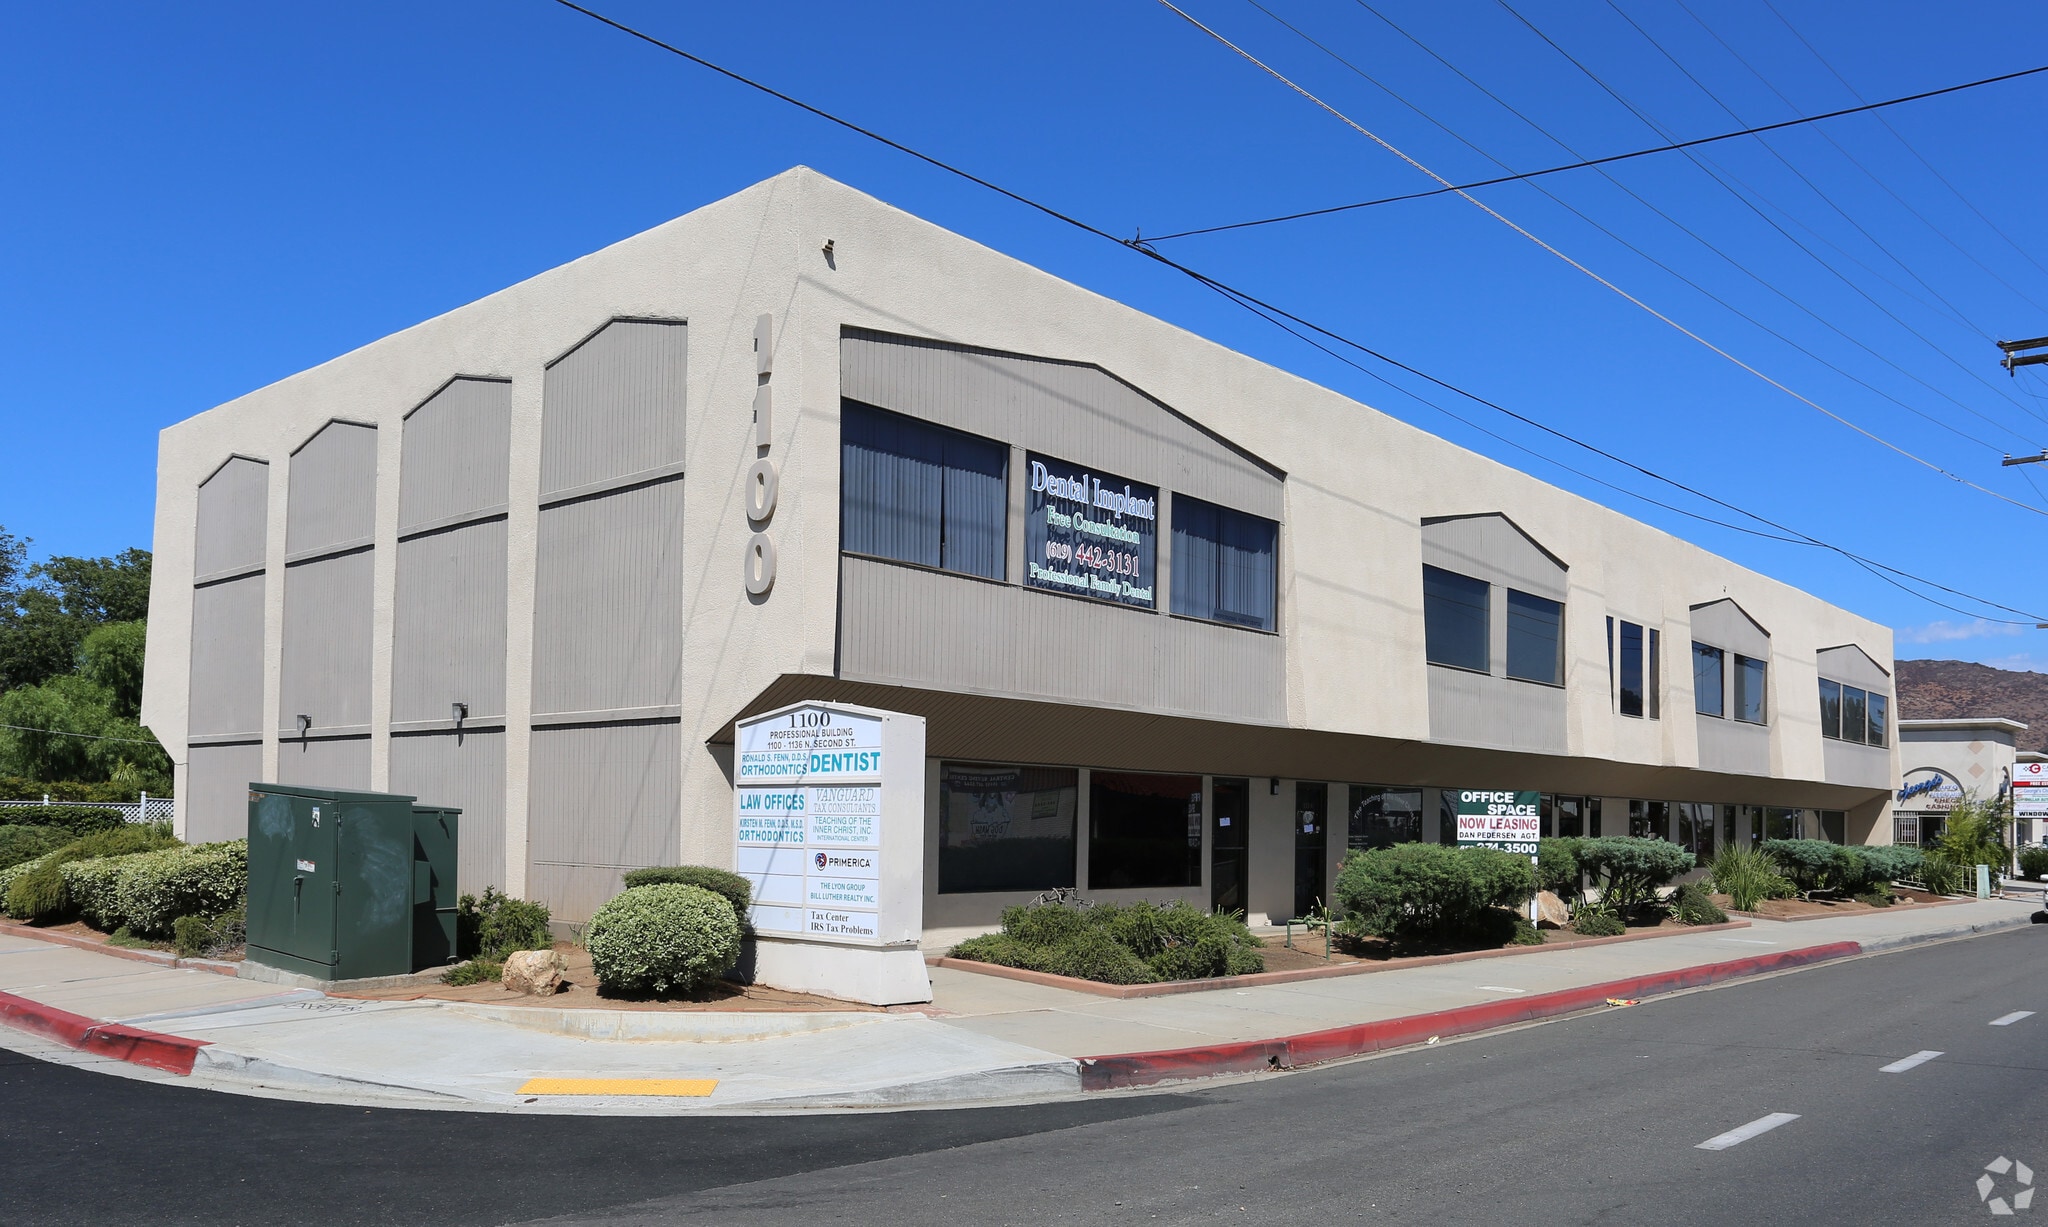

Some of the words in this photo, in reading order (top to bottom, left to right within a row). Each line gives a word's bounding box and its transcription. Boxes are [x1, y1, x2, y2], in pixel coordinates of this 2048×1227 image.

[744, 312, 779, 595] 1100
[1031, 460, 1089, 505] Dental
[1092, 477, 1155, 520] Implant
[1046, 505, 1072, 529] Free
[1072, 512, 1140, 544] Consultation
[1045, 540, 1072, 563] (619)
[1075, 543, 1140, 577] 442-3131
[1029, 562, 1089, 588] Professional
[1090, 573, 1122, 597] Family
[1122, 581, 1153, 601] Dental
[788, 711, 831, 728] 1100
[770, 729, 820, 739] PROFESSIONAL
[822, 728, 853, 737] BUILDING
[767, 741, 782, 749] 1100
[788, 740, 803, 749] 1136
[805, 740, 812, 748] N.
[813, 739, 843, 748] SECOND
[845, 739, 856, 747] ST.
[742, 754, 765, 762] RONALD
[774, 753, 791, 763] FENN,
[810, 751, 881, 773] DENTIST
[741, 763, 808, 775] ORTHODONTICS
[816, 788, 874, 802] VANGUARD
[1460, 791, 1514, 803] OFFICE
[740, 795, 762, 810] LAW
[764, 794, 805, 811] OFFICES
[813, 804, 827, 813] TAX
[828, 803, 876, 814] CONSULTANTS
[1487, 804, 1536, 816] SPACE
[740, 818, 758, 828] KIRSTEN
[815, 816, 847, 825] TEACHING
[848, 816, 858, 825] OF
[858, 817, 872, 825] THE
[1459, 817, 1486, 829] NOW
[1489, 818, 1538, 830] LEASING
[739, 830, 804, 843] ORTHODONTICS
[812, 826, 833, 834] INNER
[833, 826, 858, 835] CHRIST,
[859, 826, 873, 835] INC.
[828, 857, 871, 868] PRIMERICA
[820, 882, 831, 890] THE
[831, 882, 846, 891] LYON
[846, 883, 866, 892] GROUP
[810, 892, 822, 900] BILL
[822, 893, 843, 901] LUTHER
[843, 893, 863, 902] REALTY
[863, 894, 876, 903] INC.
[811, 911, 824, 920] Tax
[825, 912, 849, 922] Center
[810, 922, 824, 931] IRS
[826, 923, 839, 932] Tax
[841, 924, 874, 935] Problems
